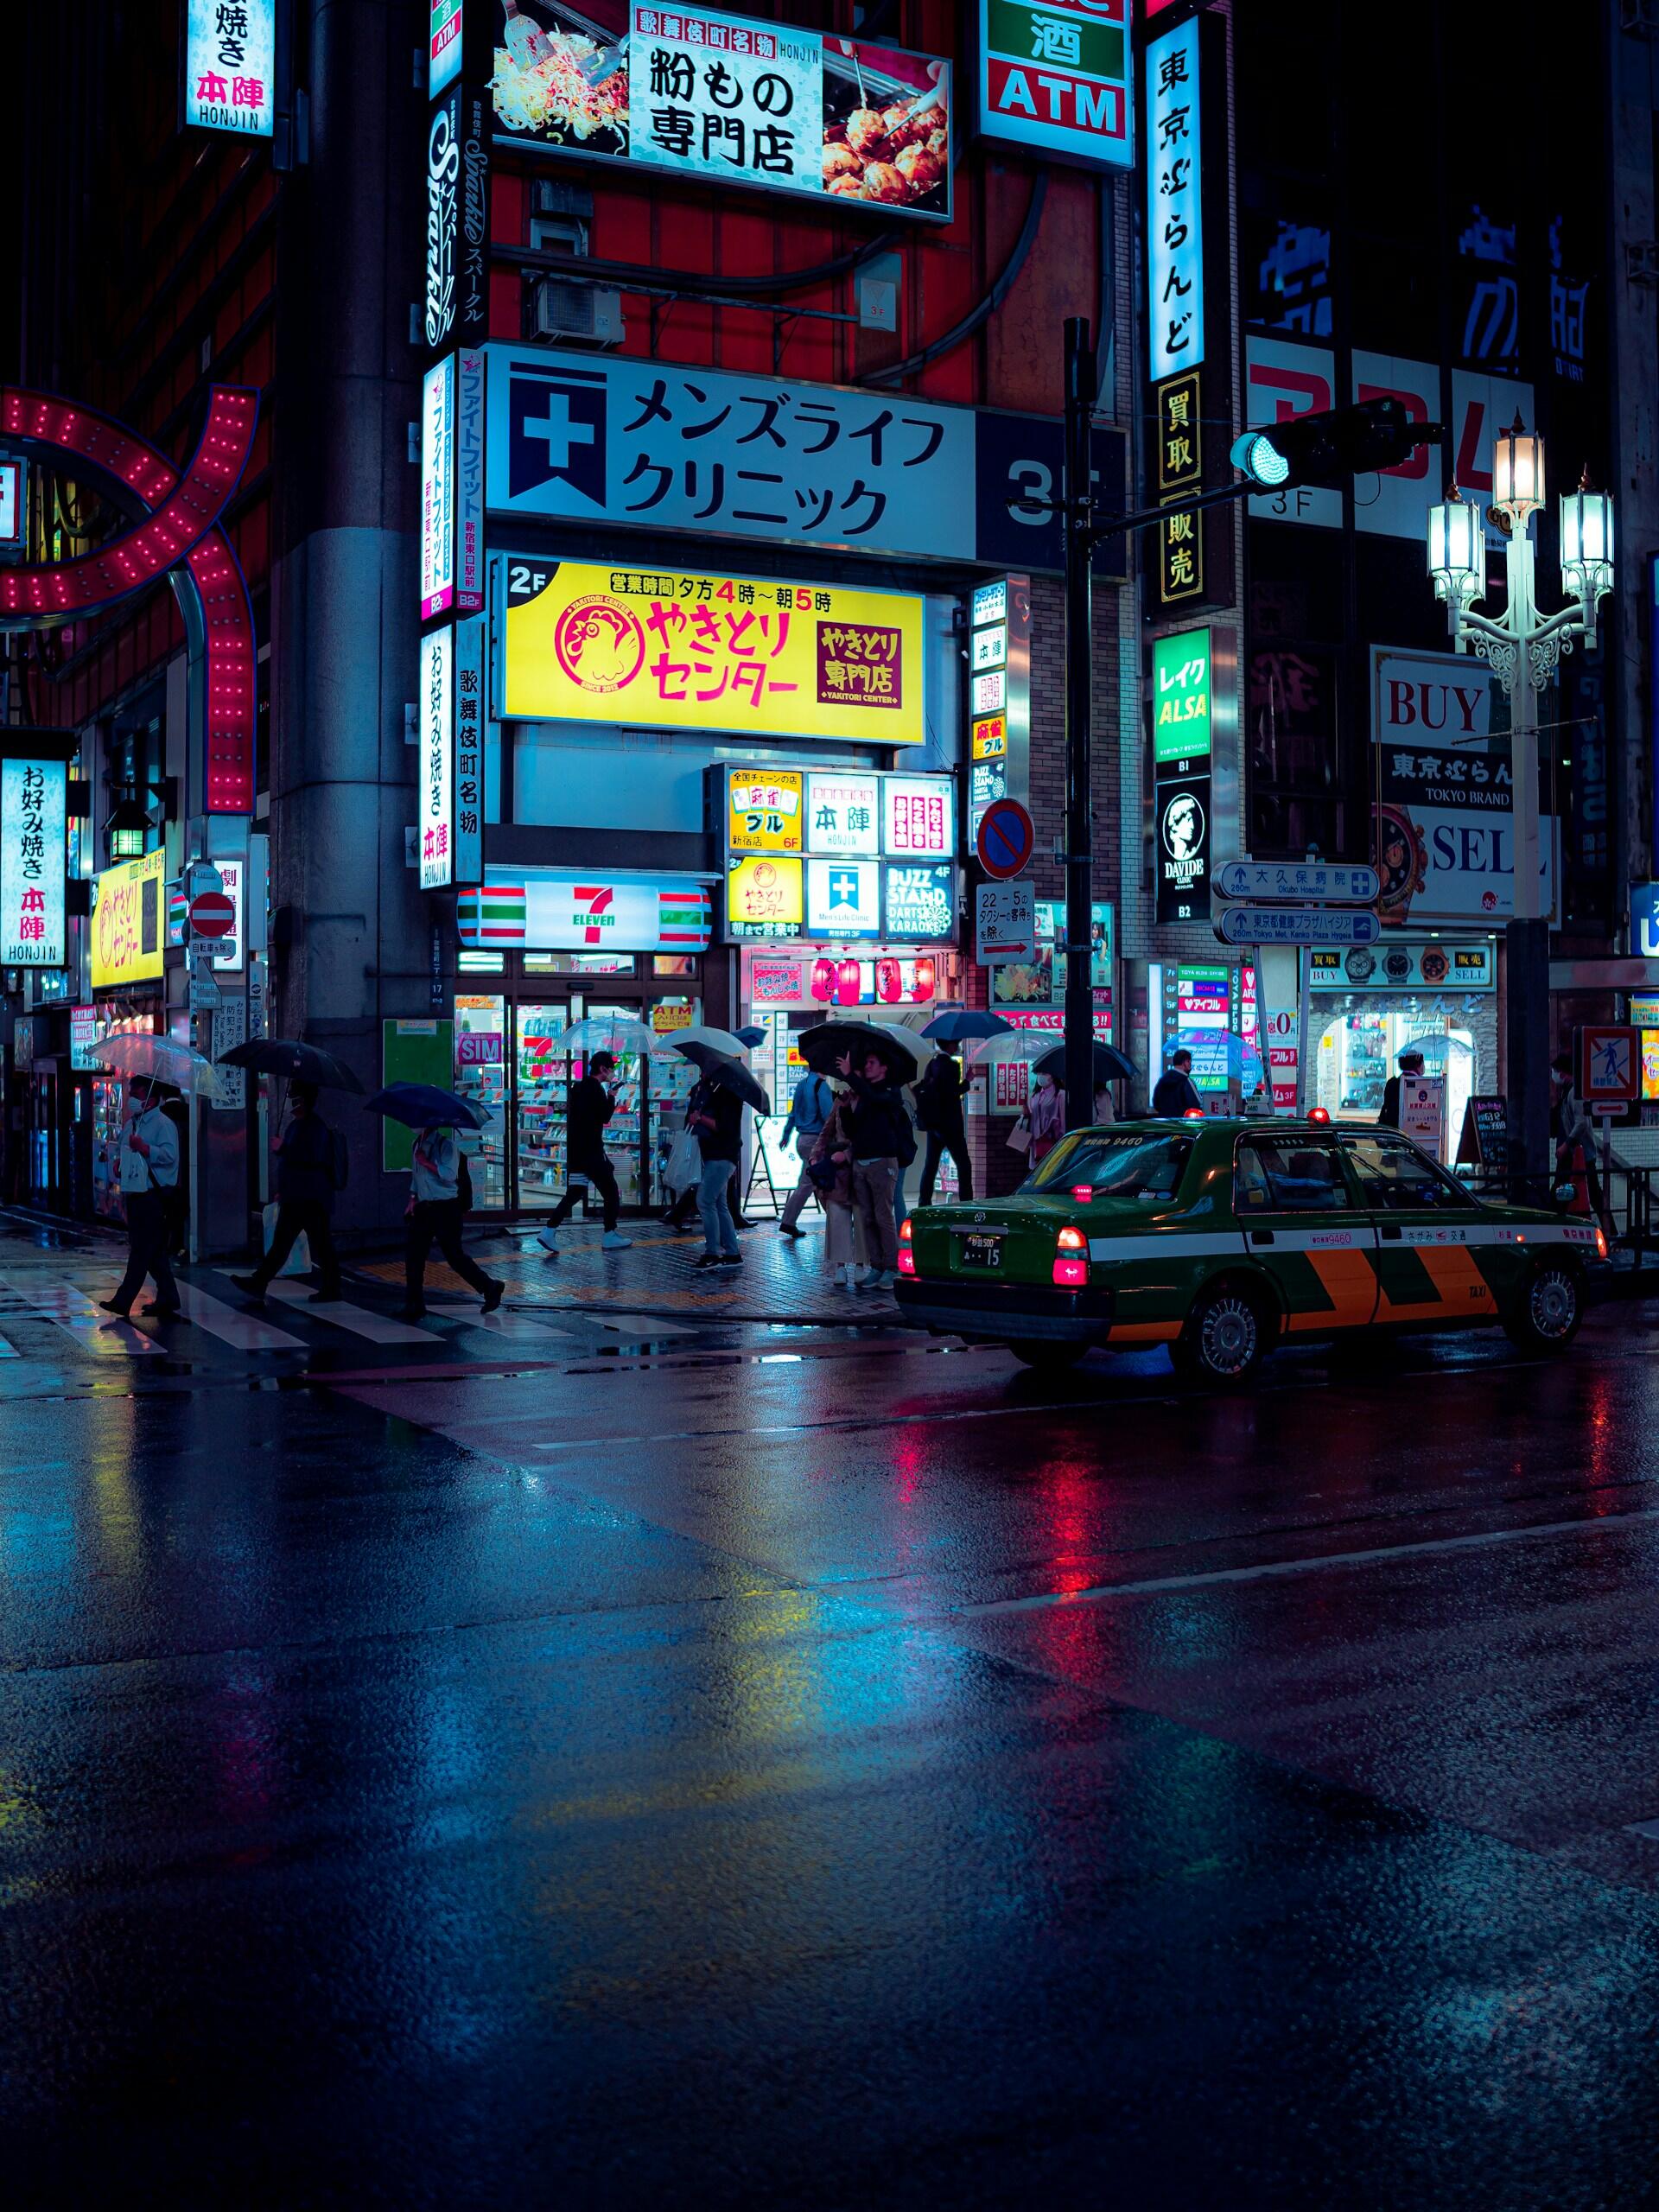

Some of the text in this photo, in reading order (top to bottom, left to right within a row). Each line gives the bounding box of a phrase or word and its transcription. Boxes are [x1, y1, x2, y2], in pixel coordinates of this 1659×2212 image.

[216, 0, 250, 67] 焼き
[437, 19, 455, 52] ATM
[639, 10, 818, 64] 歌舞伎町名物 HONJIN
[1031, 13, 1082, 65] 酒
[197, 71, 264, 109] 本陣
[650, 48, 793, 117] 粉もの
[998, 68, 1116, 132] ATM
[200, 105, 258, 130] HONJIN
[650, 105, 795, 175] 専門店
[439, 185, 457, 342] スパークル
[464, 248, 484, 322] スパークル
[623, 379, 944, 467] メンズライフ
[1167, 391, 1192, 473] 買取
[461, 374, 481, 518] ファイトフィット
[623, 453, 887, 535] クリニック
[1272, 489, 1313, 517] 3F
[465, 522, 475, 588] 新宿東口駅前
[1168, 512, 1194, 588] 販売
[510, 566, 546, 594] 2F
[612, 574, 674, 595] 営業時間
[459, 594, 480, 607] B2F
[571, 594, 631, 614] YAKITORI CENTER
[646, 601, 790, 658] やきとり
[821, 627, 899, 662] やきとり
[650, 652, 798, 708] センター
[824, 660, 893, 693] 専門店
[1160, 658, 1205, 692] レイク
[581, 681, 601, 692] SINCE
[827, 692, 893, 704] YAKITORI CENTER
[1387, 680, 1484, 732] BUY
[1159, 694, 1206, 725] ALSA
[430, 646, 442, 817] お好み焼き
[460, 670, 477, 834] 歌舞伎町名物
[996, 763, 1004, 772] 4F
[1392, 753, 1512, 785] 東京ぶらん
[734, 772, 797, 785] 全国チェーンの店
[751, 787, 779, 806] 麻雀
[1426, 787, 1510, 806] TOKYO BRAND
[21, 766, 44, 880] お好み焼き
[816, 805, 870, 831] 本陣
[423, 823, 448, 861] 本陣
[733, 836, 798, 848] 新宿店 6F
[828, 834, 856, 846] HONJIN
[1433, 825, 1547, 875] SEL
[424, 861, 447, 886] HONJIN
[888, 867, 950, 887] BUZZ 4F
[1165, 858, 1205, 879] DAVIDE
[1256, 869, 1345, 886] 大久保病院
[746, 890, 784, 903] やきとり
[887, 887, 946, 904] STAND
[982, 893, 996, 907] 22
[20, 887, 46, 941] 本陣
[747, 905, 785, 917] センター
[851, 913, 869, 922] Clinic
[980, 909, 1031, 924] タクシーの客待ち
[1179, 906, 1191, 918] B2
[732, 922, 799, 936] 朝まで営業中
[889, 920, 939, 933] KARAOKE
[1254, 914, 1352, 930] 東京都健康プラザハイジア
[980, 926, 1004, 941] を除く
[1232, 929, 1252, 938] 260m
[1254, 930, 1273, 939] Tokyo
[9, 945, 56, 960] HONJIN
[192, 943, 232, 953] 自転車を除く
[1313, 970, 1485, 981] BUY SELL
[432, 984, 442, 993] 17
[654, 1006, 691, 1014] ATM
[1193, 999, 1220, 1010] アイフル
[461, 1039, 499, 1060] SIM
[1285, 1090, 1294, 1099] 3F
[1113, 1136, 1143, 1146] 9460
[1329, 1233, 1351, 1244] 9460
[1408, 1230, 1466, 1242] さがみ 交通
[1469, 1285, 1486, 1299] TAXI
